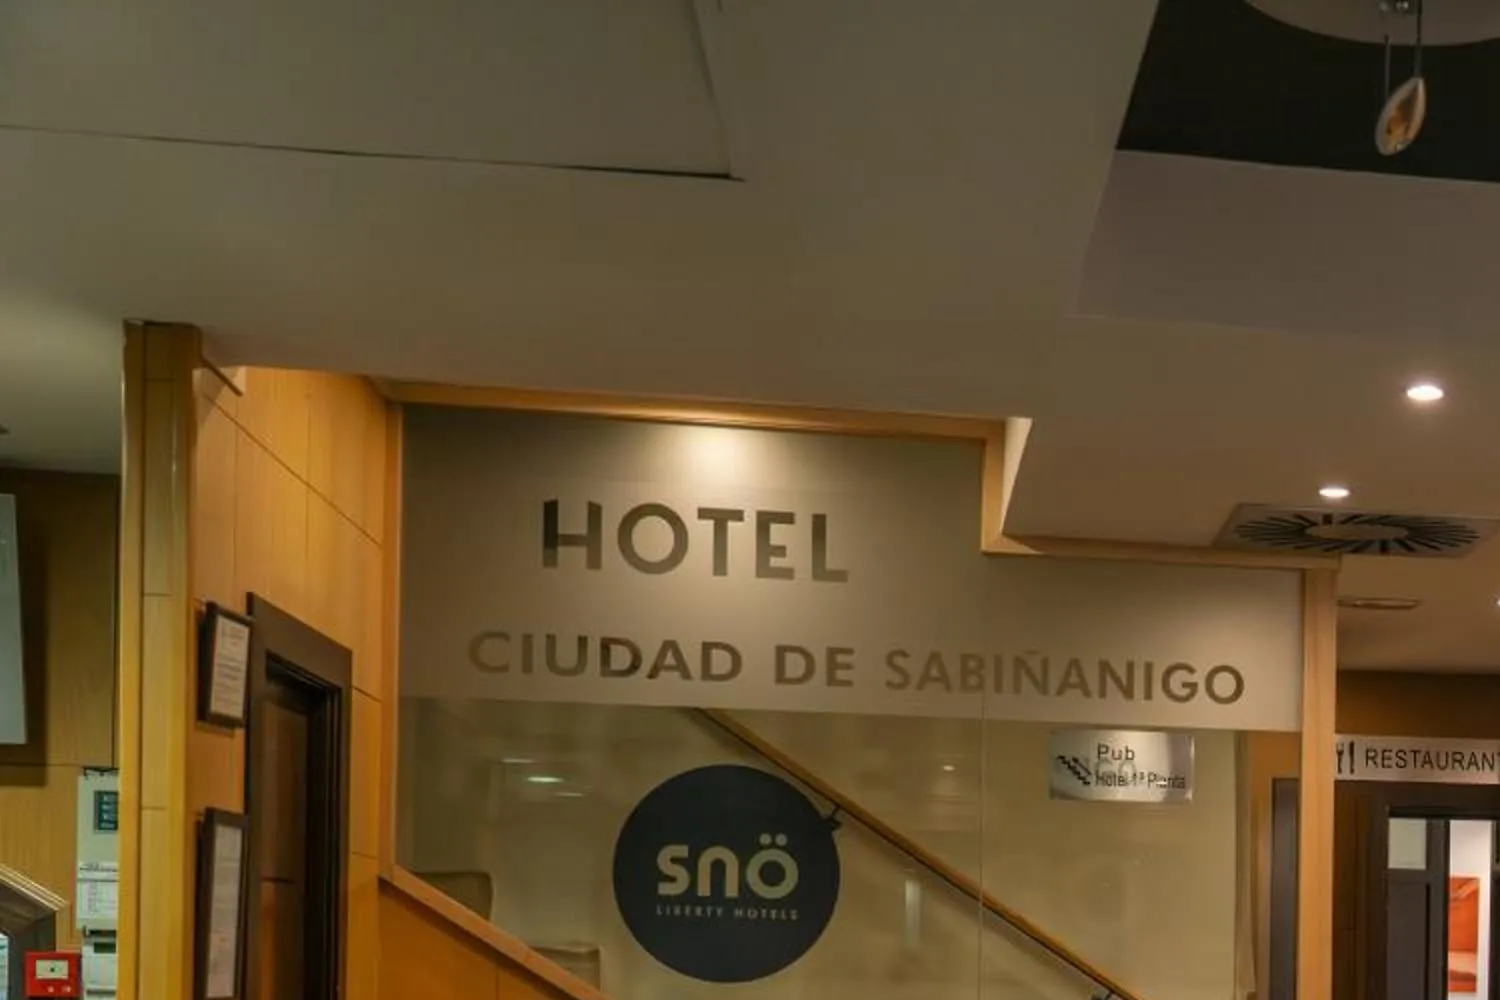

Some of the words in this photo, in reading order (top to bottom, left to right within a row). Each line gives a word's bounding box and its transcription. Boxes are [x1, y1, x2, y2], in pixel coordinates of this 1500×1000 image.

[542, 498, 849, 583] HOTEL
[468, 630, 743, 681] CIUDAD
[773, 644, 855, 687] DE
[885, 648, 1245, 705] SABIÑANIGO
[1097, 743, 1136, 761] Pub
[655, 903, 724, 918] LIBERTY
[733, 907, 799, 921] HOTELS
